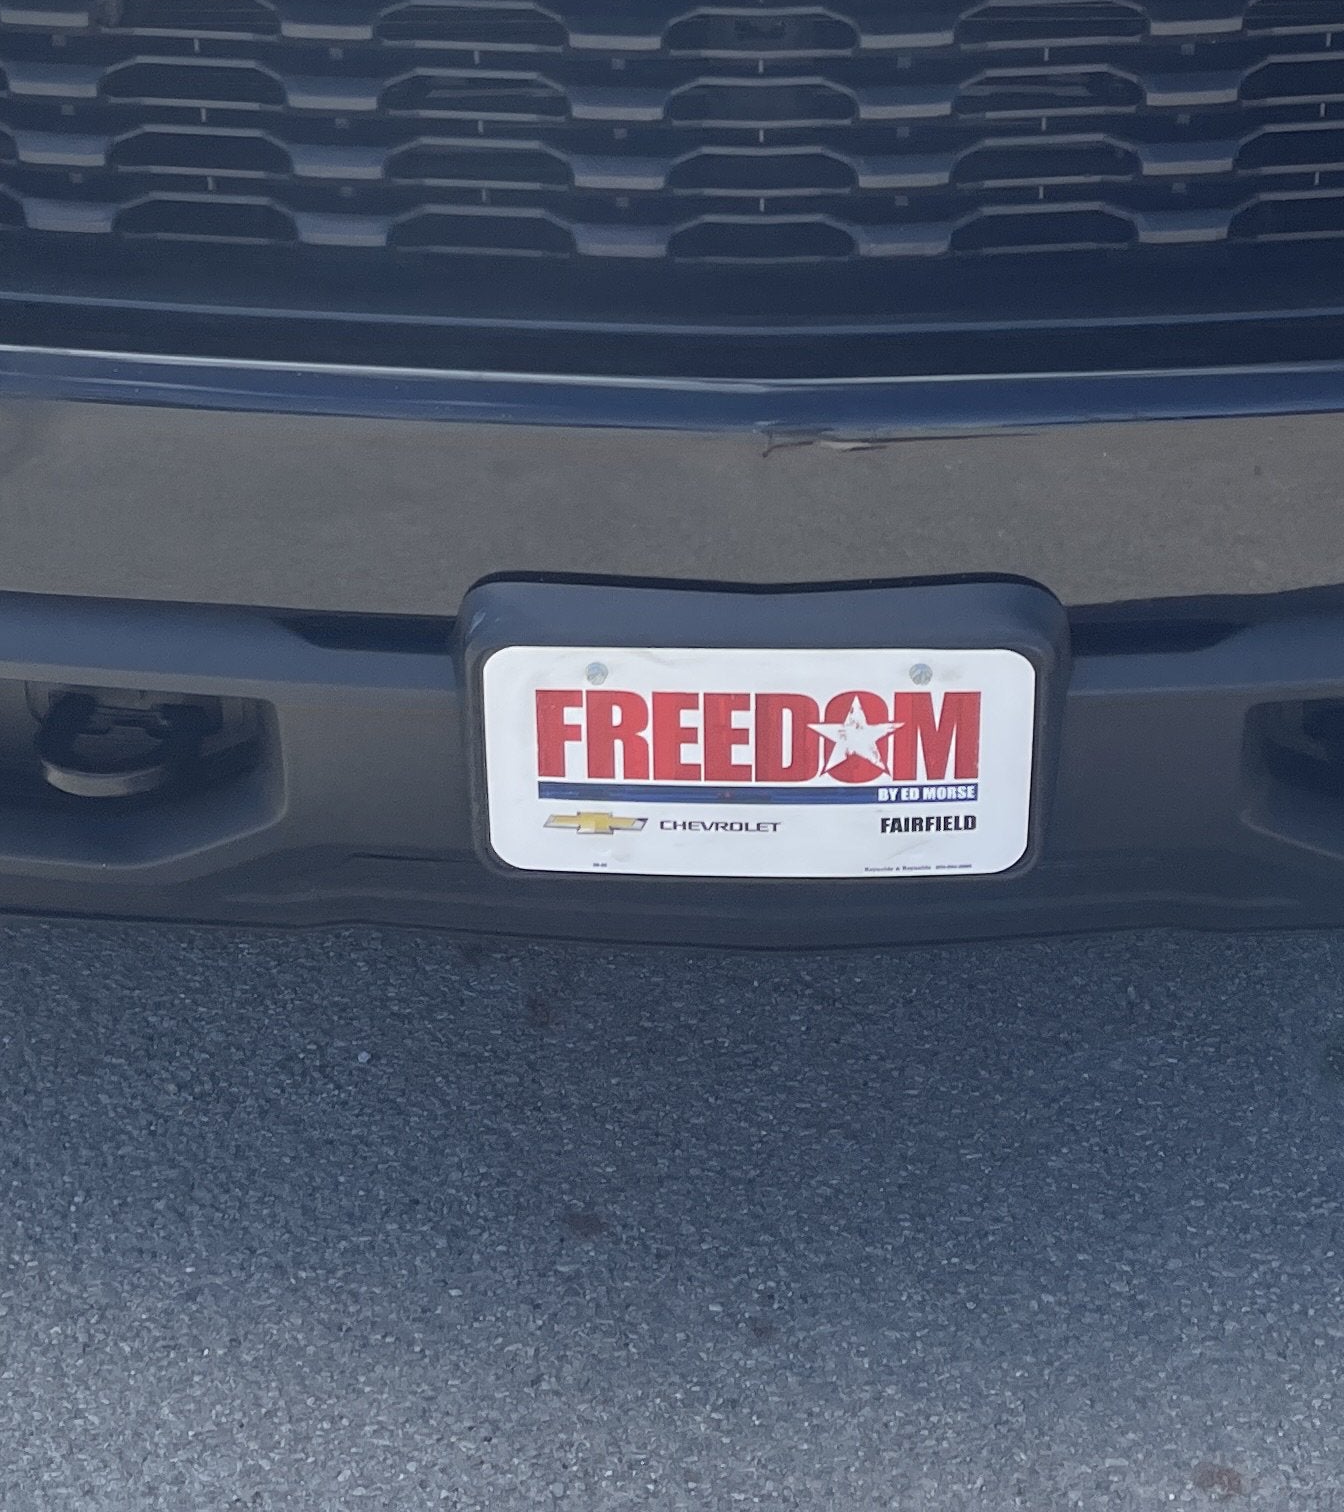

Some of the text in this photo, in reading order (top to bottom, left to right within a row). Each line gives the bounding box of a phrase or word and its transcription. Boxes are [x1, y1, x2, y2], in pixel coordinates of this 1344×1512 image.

[535, 689, 982, 783] FREEDOM
[878, 785, 976, 801] BY ED MORSE
[659, 819, 782, 833] CHEVROLET
[880, 815, 977, 833] FAIRFIELD
